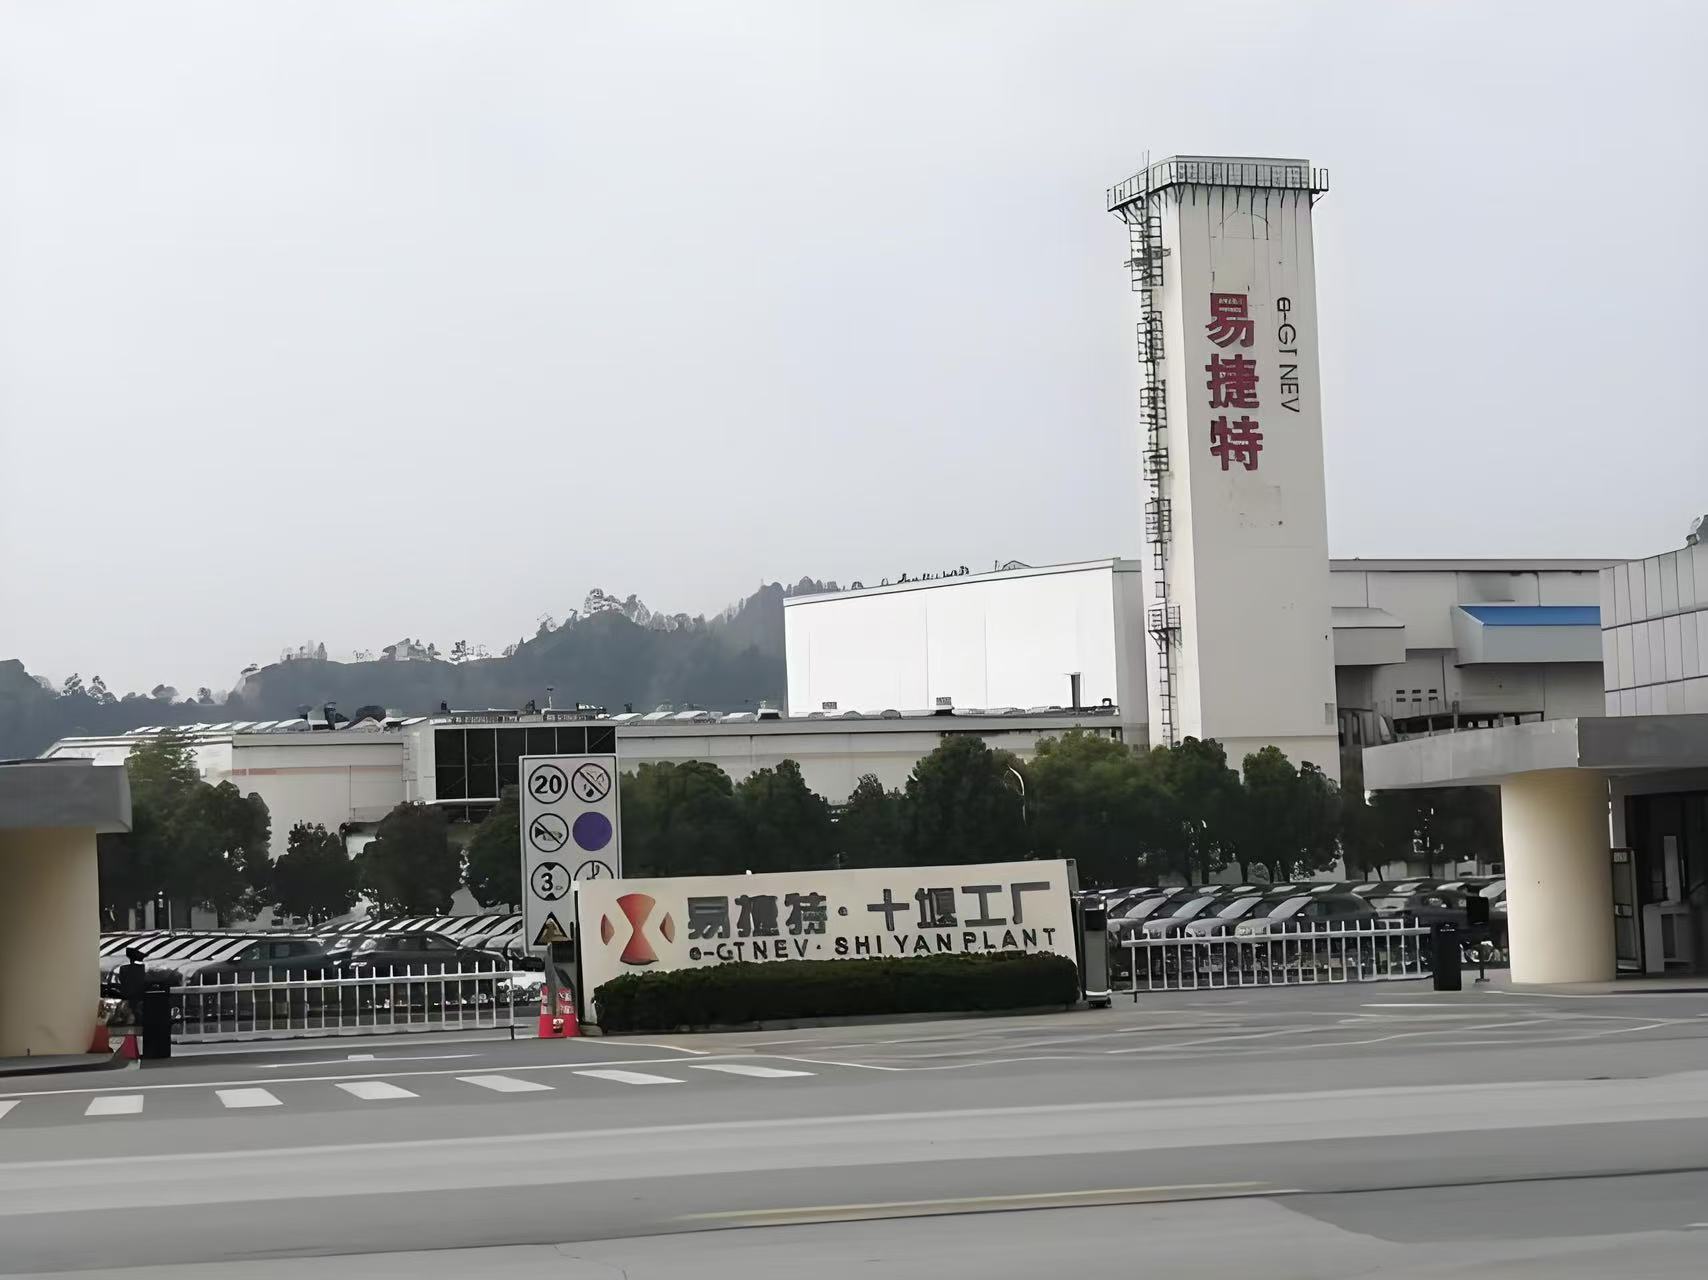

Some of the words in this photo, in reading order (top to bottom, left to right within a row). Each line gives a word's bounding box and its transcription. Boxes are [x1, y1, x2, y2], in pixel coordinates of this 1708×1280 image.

[1205, 293, 1263, 471] 易捷特
[534, 775, 562, 794] 20
[962, 928, 1056, 951] PLANT
